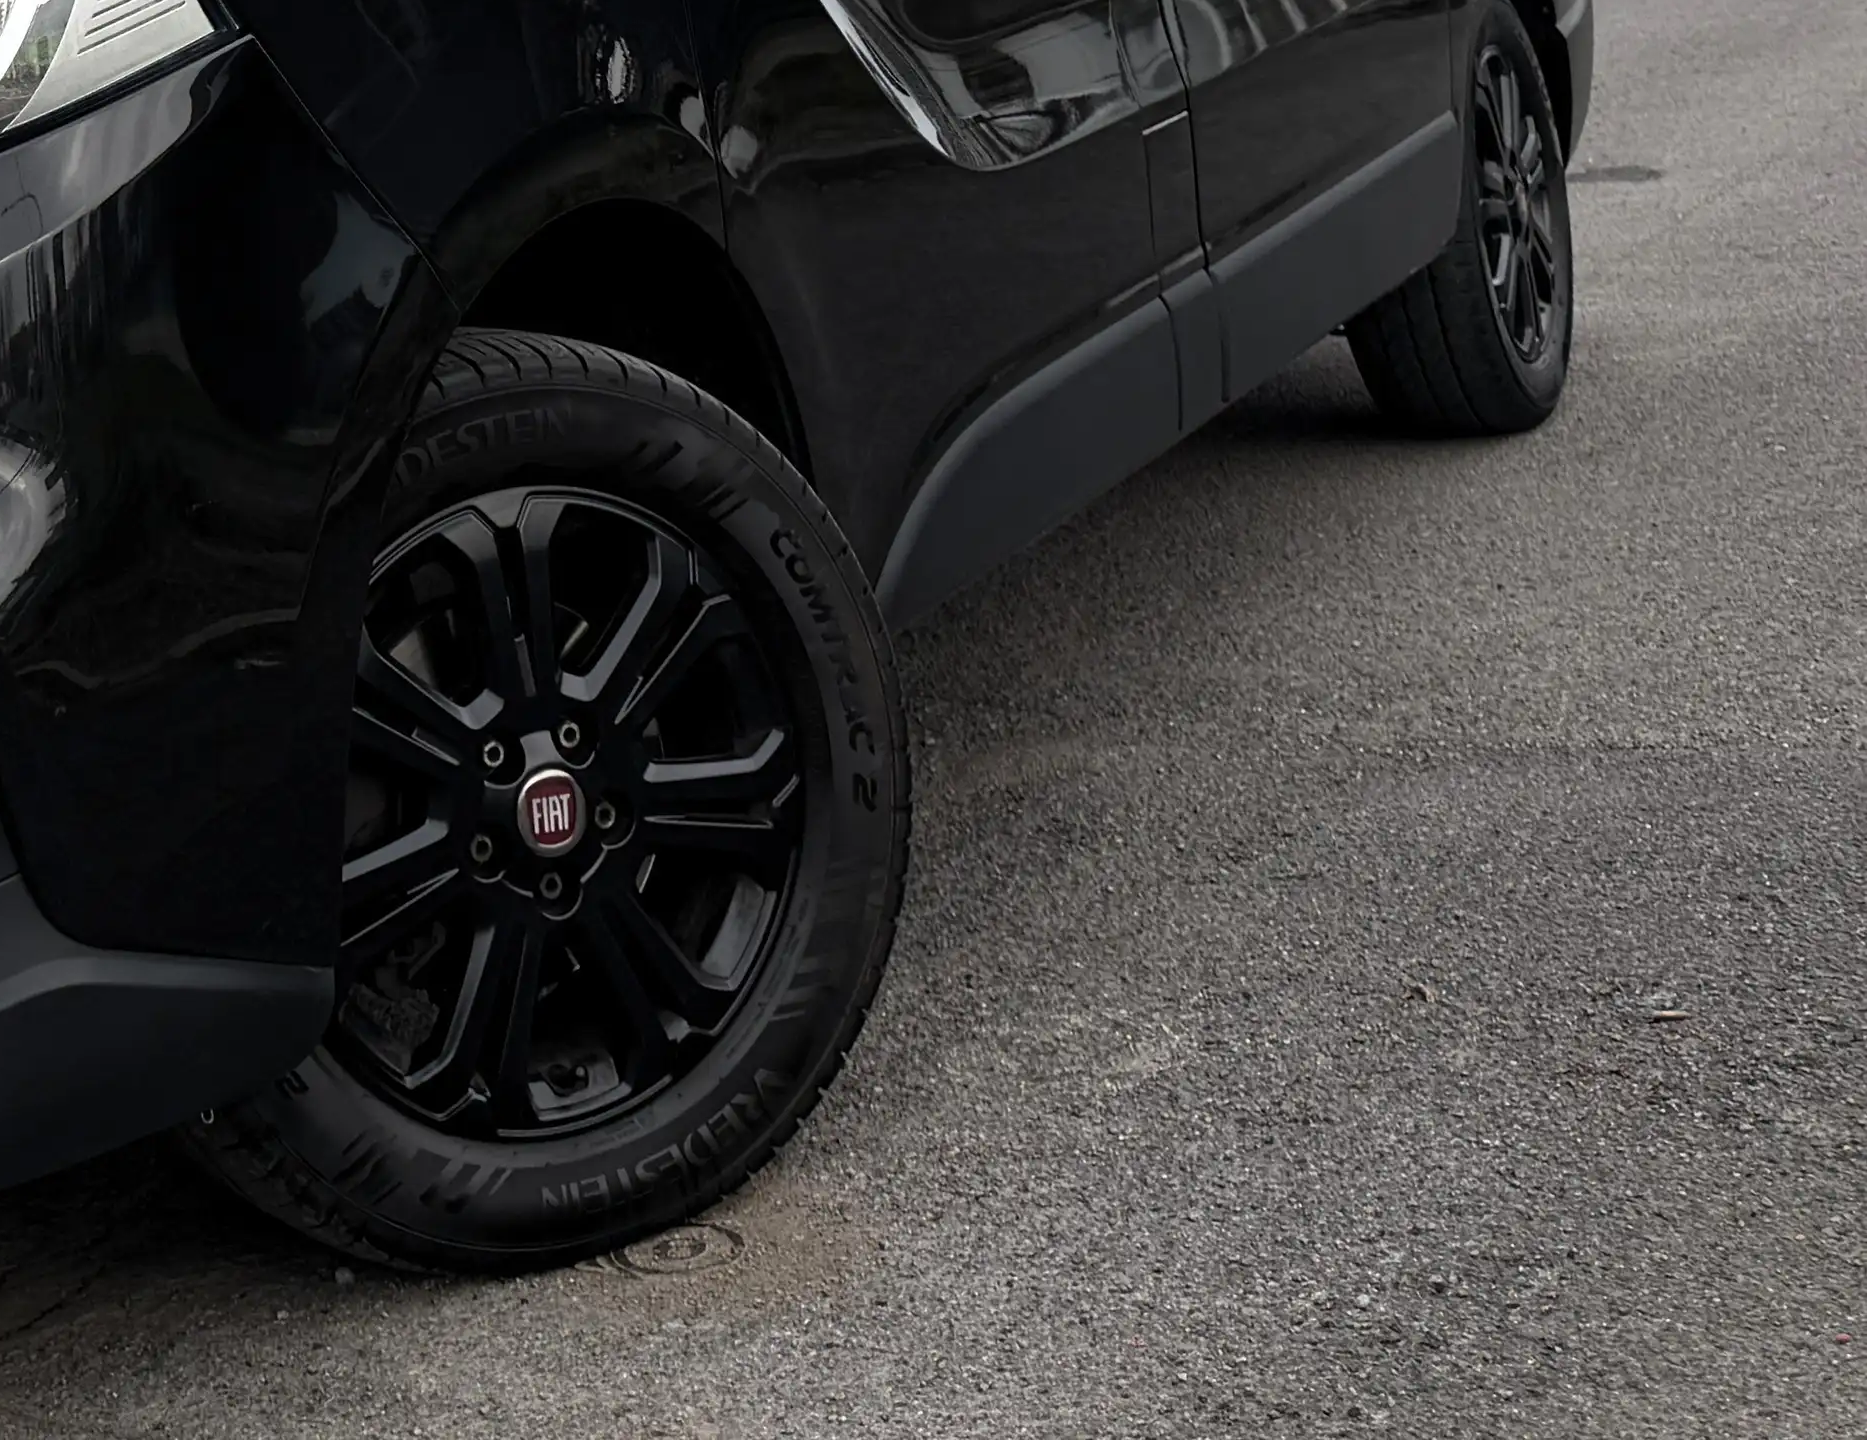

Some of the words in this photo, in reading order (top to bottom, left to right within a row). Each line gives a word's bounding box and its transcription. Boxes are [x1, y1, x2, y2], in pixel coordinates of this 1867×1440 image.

[395, 398, 572, 486] DESTEIN
[852, 772, 877, 812] 2
[532, 793, 571, 835] FIAT
